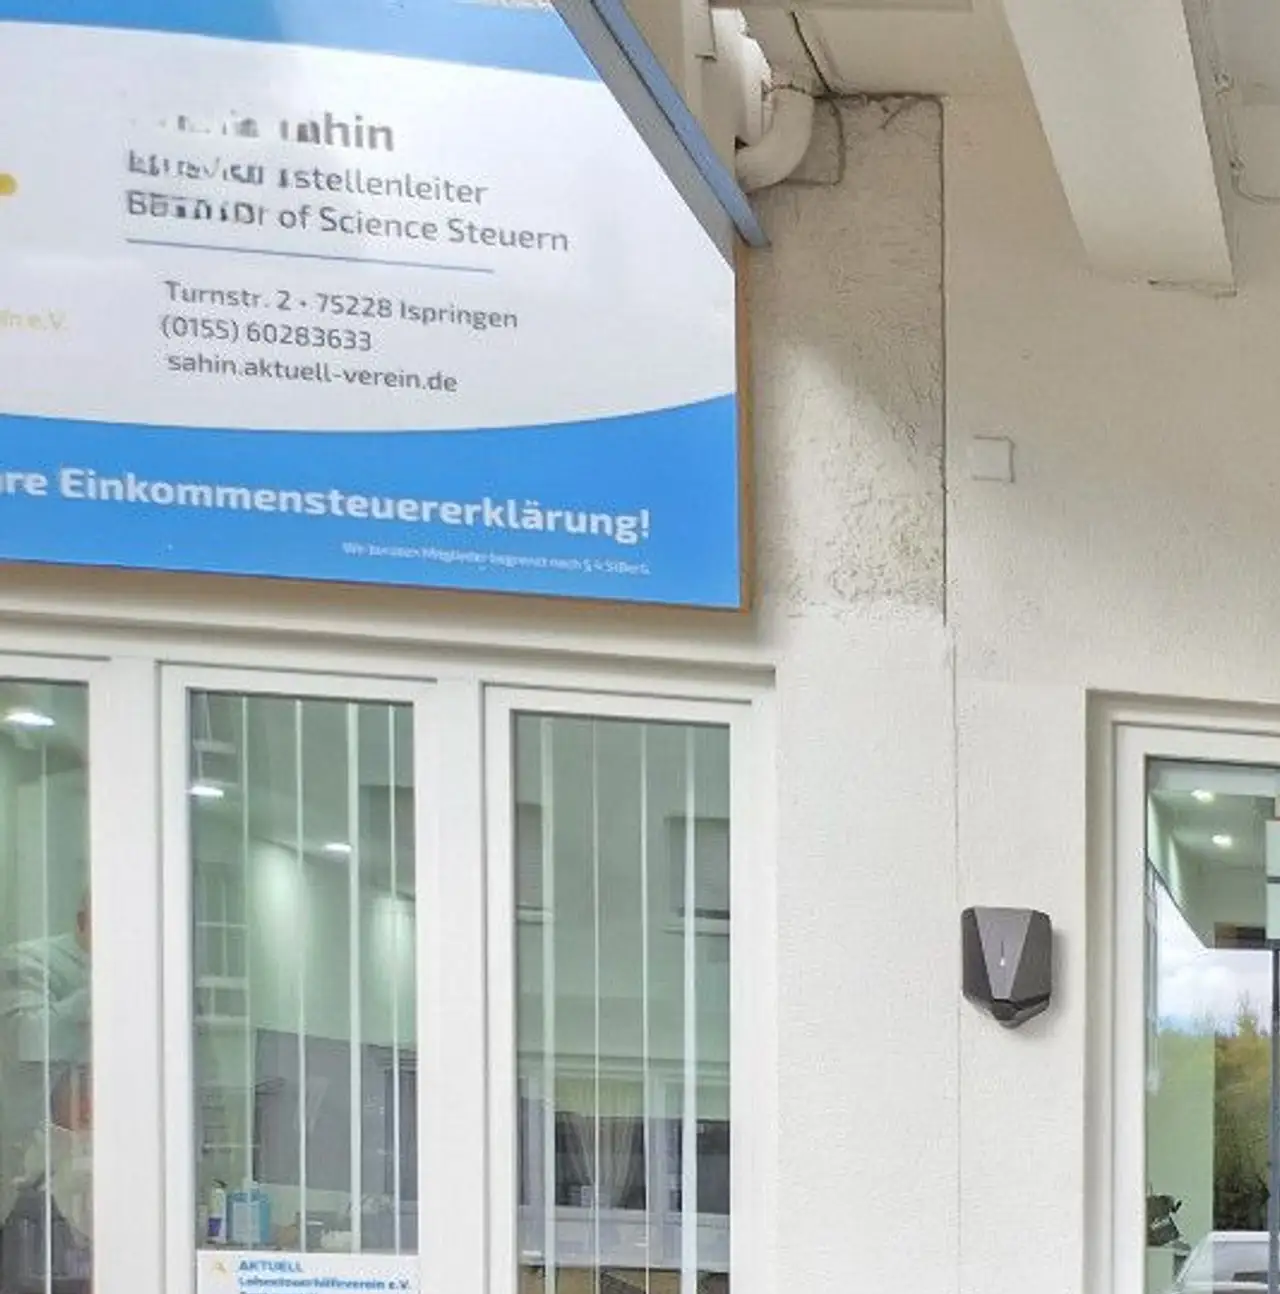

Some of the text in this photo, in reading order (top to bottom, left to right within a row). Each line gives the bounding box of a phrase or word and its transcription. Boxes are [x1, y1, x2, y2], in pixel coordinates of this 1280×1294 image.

[279, 205, 311, 230] of
[319, 206, 438, 241] Science
[450, 218, 570, 251] Steuern
[164, 280, 519, 331] Turnstr. 2 75228 Ispringen
[160, 315, 372, 351] (0155) 60283633
[167, 352, 459, 393] sahin.aktuell-verein.de
[60, 467, 650, 542] Einkommensteuererklärung!
[239, 1260, 303, 1273] AKTUELL
